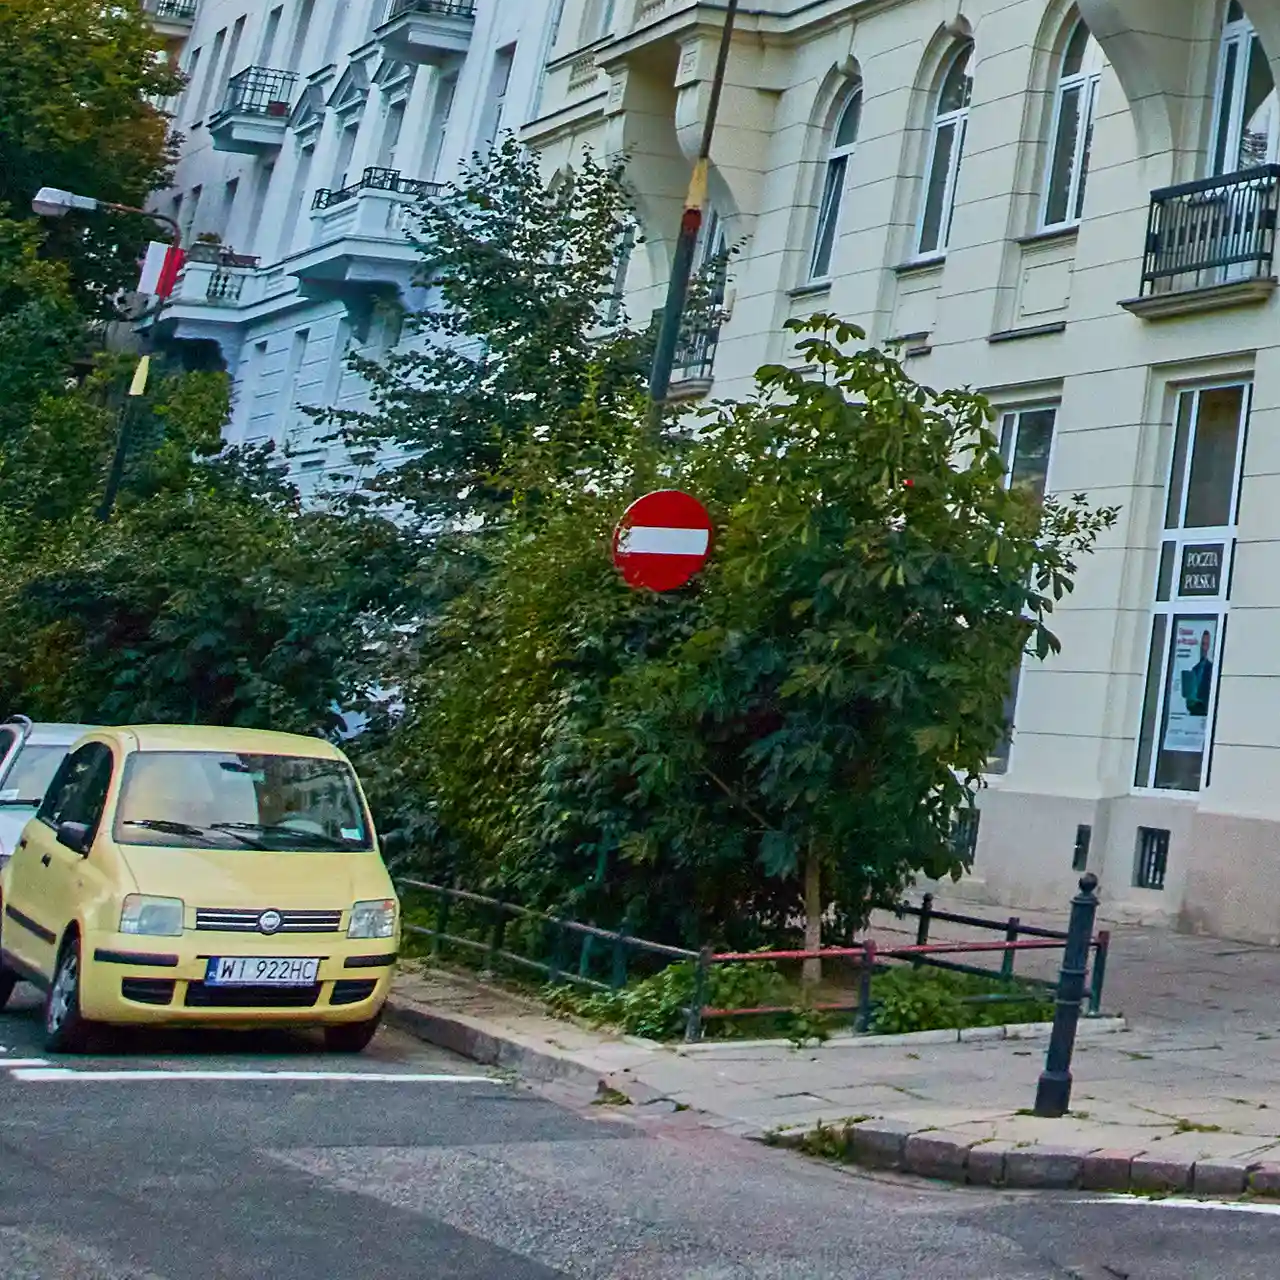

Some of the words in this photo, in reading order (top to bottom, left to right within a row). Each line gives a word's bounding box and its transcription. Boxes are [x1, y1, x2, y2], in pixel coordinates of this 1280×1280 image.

[1187, 552, 1218, 568] POCZTA
[1184, 573, 1216, 589] POLSKA
[221, 960, 246, 979] WI
[256, 960, 314, 979] 922HC
